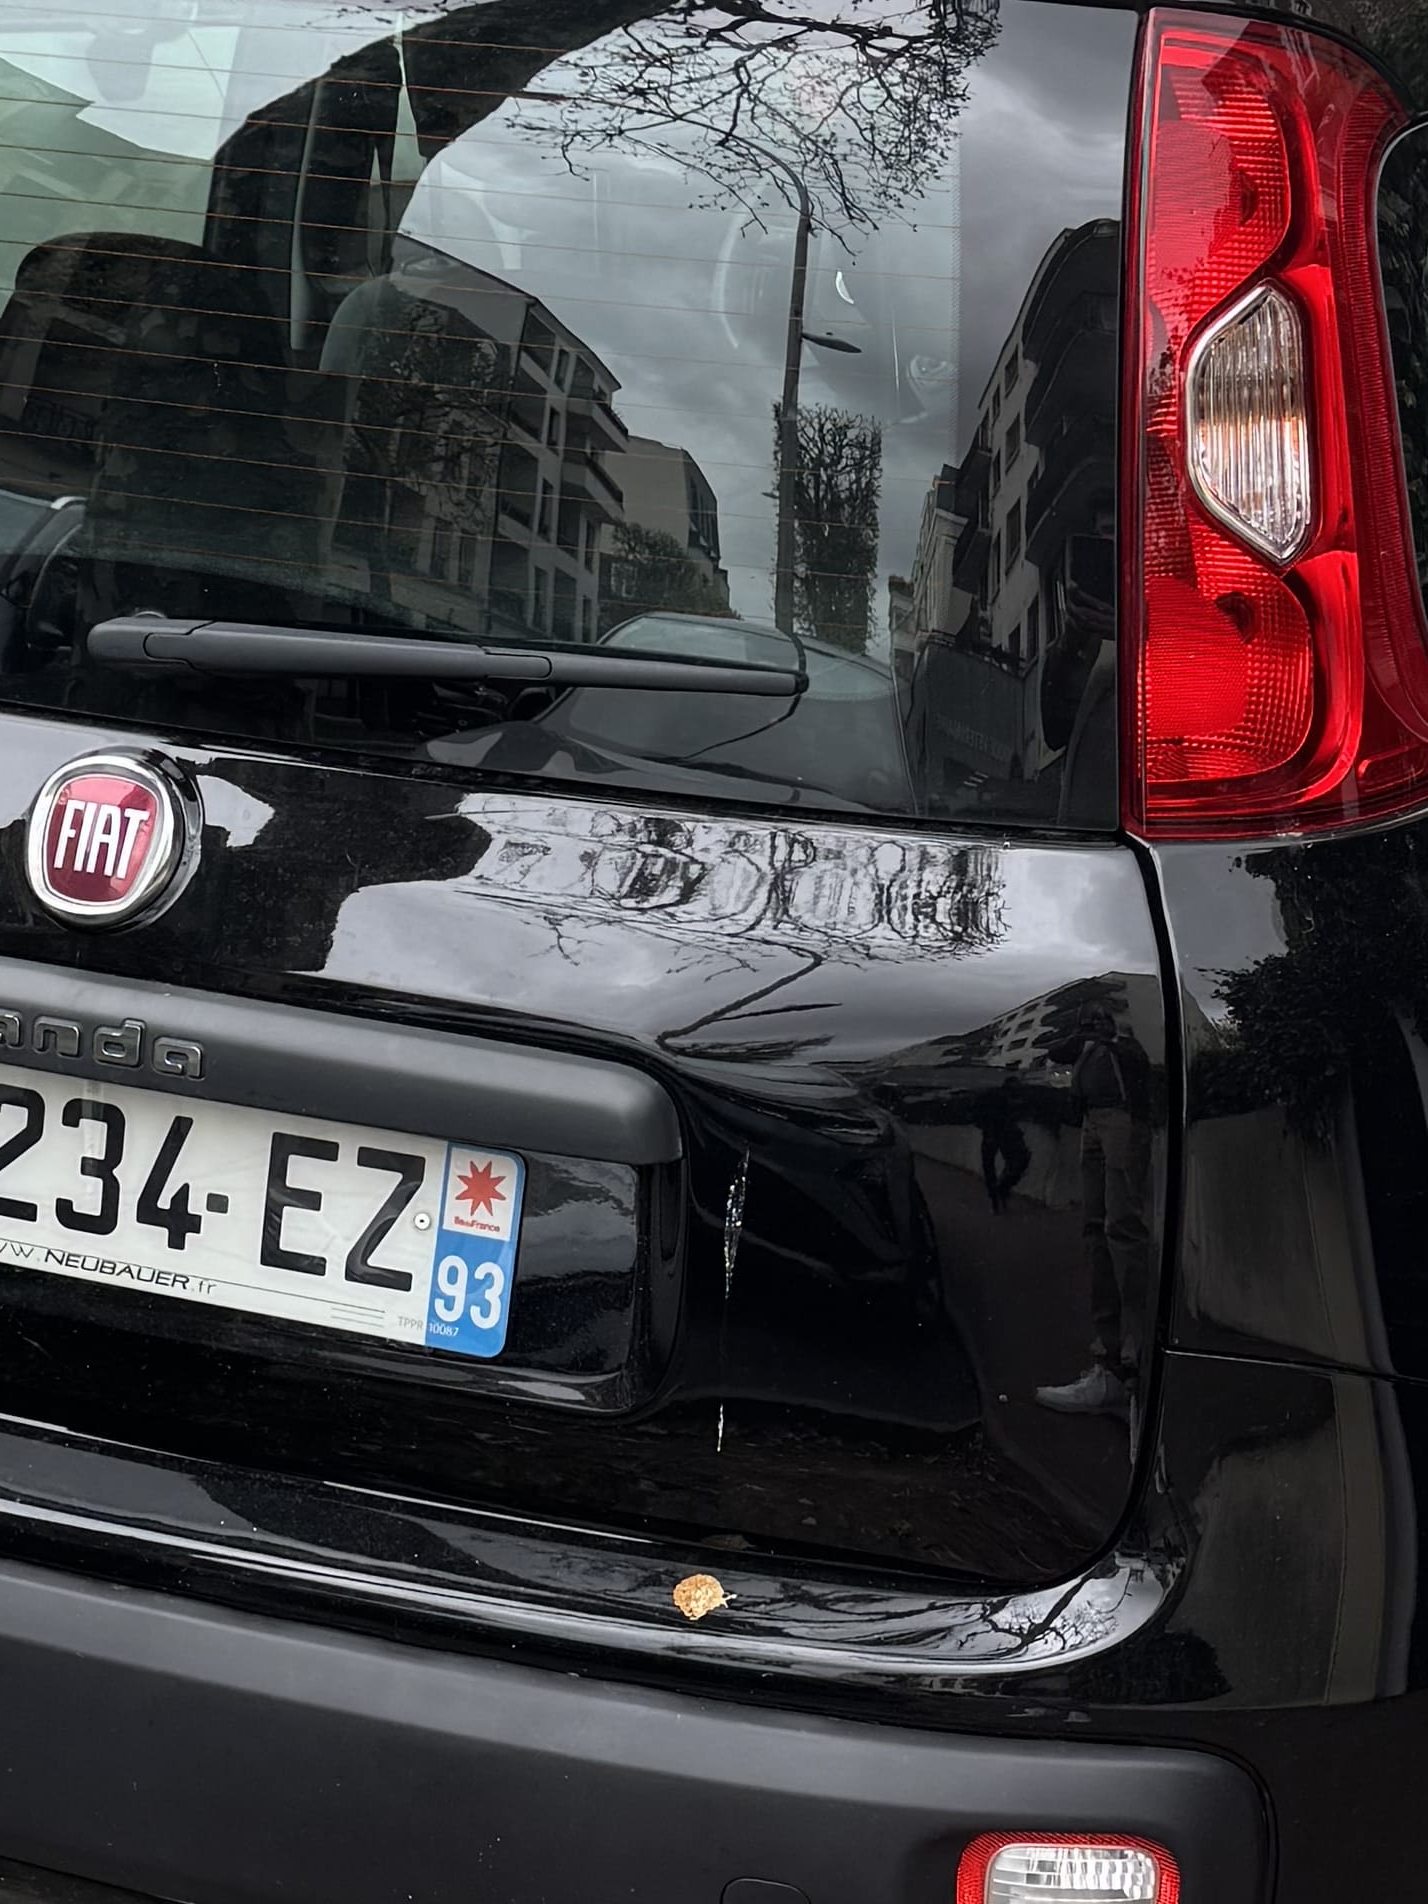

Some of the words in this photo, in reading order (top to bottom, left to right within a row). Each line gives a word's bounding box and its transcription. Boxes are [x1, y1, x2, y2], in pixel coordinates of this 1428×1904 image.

[53, 798, 150, 880] FIAT
[428, 1321, 460, 1337] 10087
[434, 1254, 505, 1330] 93
